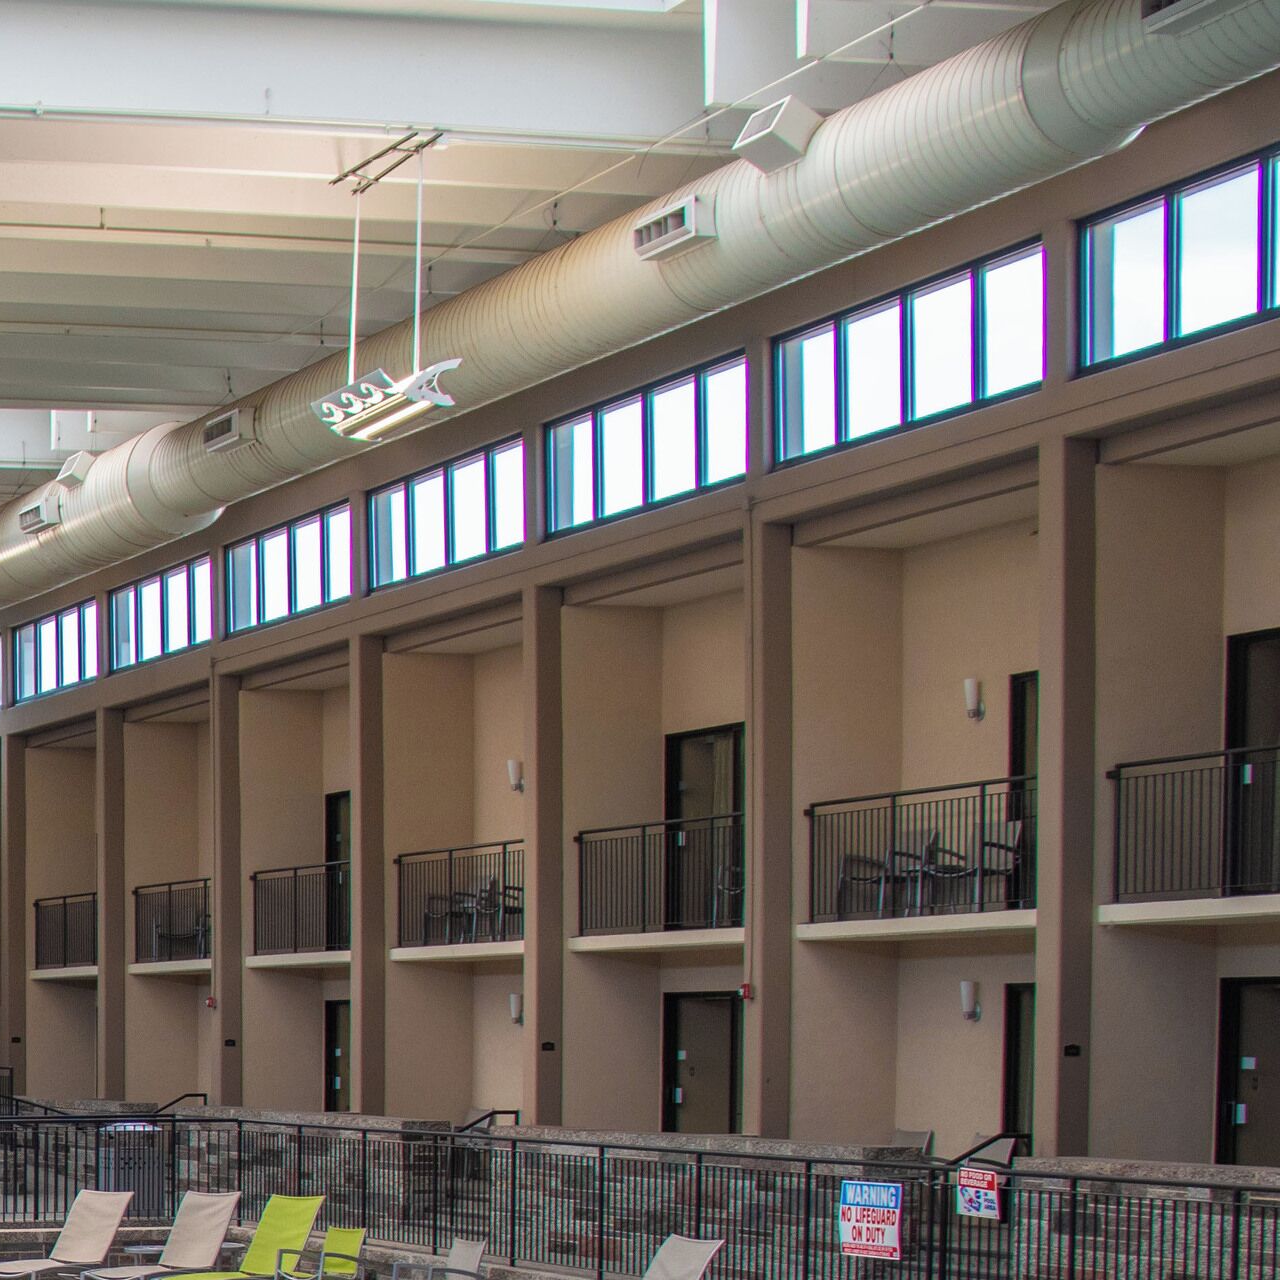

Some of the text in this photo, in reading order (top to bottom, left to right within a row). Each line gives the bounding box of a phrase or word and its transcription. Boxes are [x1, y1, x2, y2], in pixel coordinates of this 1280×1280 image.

[845, 1184, 897, 1208] WARNING
[841, 1206, 896, 1226] NO LIFEGUARD
[852, 1225, 886, 1244] ON DUTY
